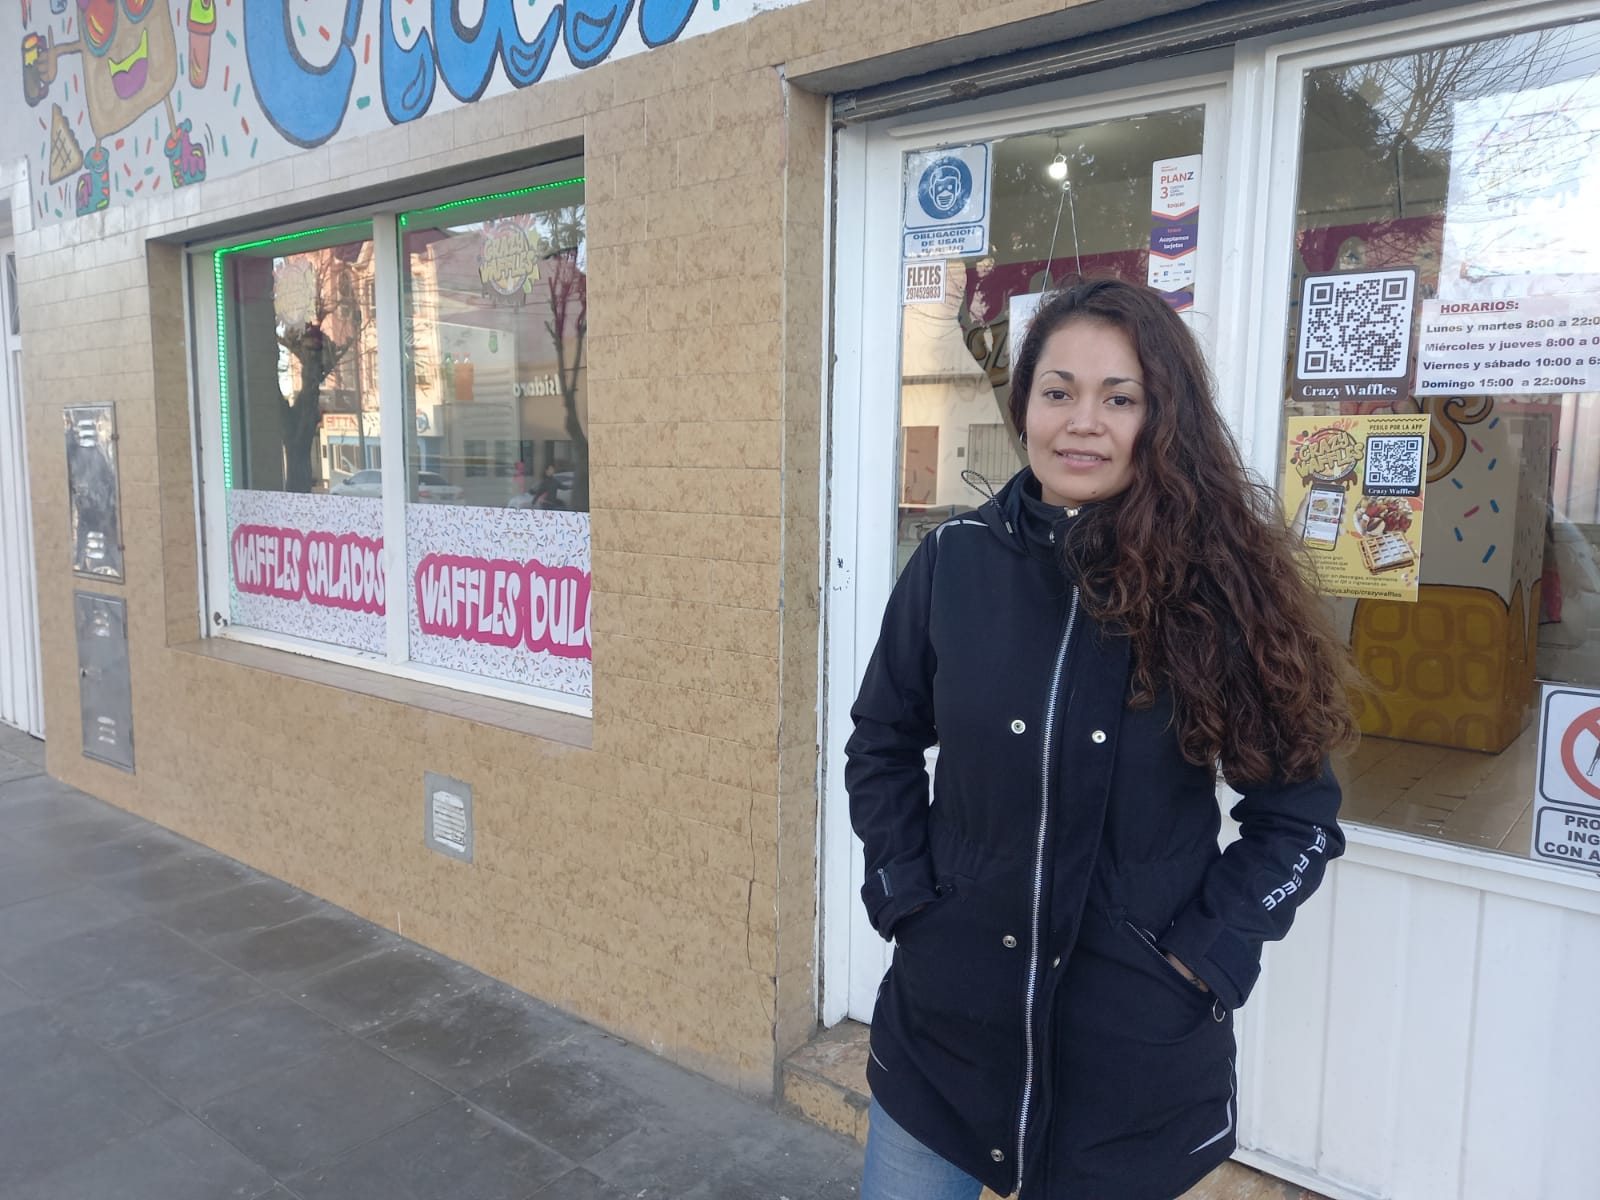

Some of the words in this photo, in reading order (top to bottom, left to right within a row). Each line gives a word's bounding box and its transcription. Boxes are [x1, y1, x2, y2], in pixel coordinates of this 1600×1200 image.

[1160, 186, 1168, 200] 3
[907, 265, 942, 287] FLETES
[1440, 301, 1520, 314] HORARIOS:
[1426, 324, 1463, 334] Lunes
[1466, 325, 1474, 333] y
[1478, 321, 1522, 331] martes
[1526, 319, 1554, 328] 8:00
[1424, 342, 1484, 352] Miércoles
[1488, 343, 1496, 351] y
[1500, 340, 1542, 350] jueves
[1546, 338, 1574, 347] 8:00
[1579, 338, 1588, 346] a
[1423, 361, 1470, 370] Viernes
[1473, 362, 1480, 371] y
[1484, 358, 1530, 368] sábado
[1536, 358, 1572, 367] 10:00
[1576, 358, 1584, 366] a
[1422, 379, 1476, 390] Domingo
[1479, 378, 1514, 387] 15:00
[1533, 376, 1586, 386] 22:00hs
[1302, 385, 1341, 399] Crazy
[1345, 384, 1398, 396] Waffles
[1299, 432, 1349, 461] CRAZY
[1296, 442, 1364, 478] WAFFLES
[1368, 488, 1388, 496] Crazy
[234, 533, 302, 592] WAFFLES
[306, 540, 386, 606] SALADOS
[420, 564, 521, 638] WAFFLES
[1564, 815, 1600, 830] PRO
[1568, 830, 1600, 846] ING
[1544, 842, 1582, 858] CON
[1588, 850, 1600, 862] A
[1262, 853, 1310, 911] FLEECE
